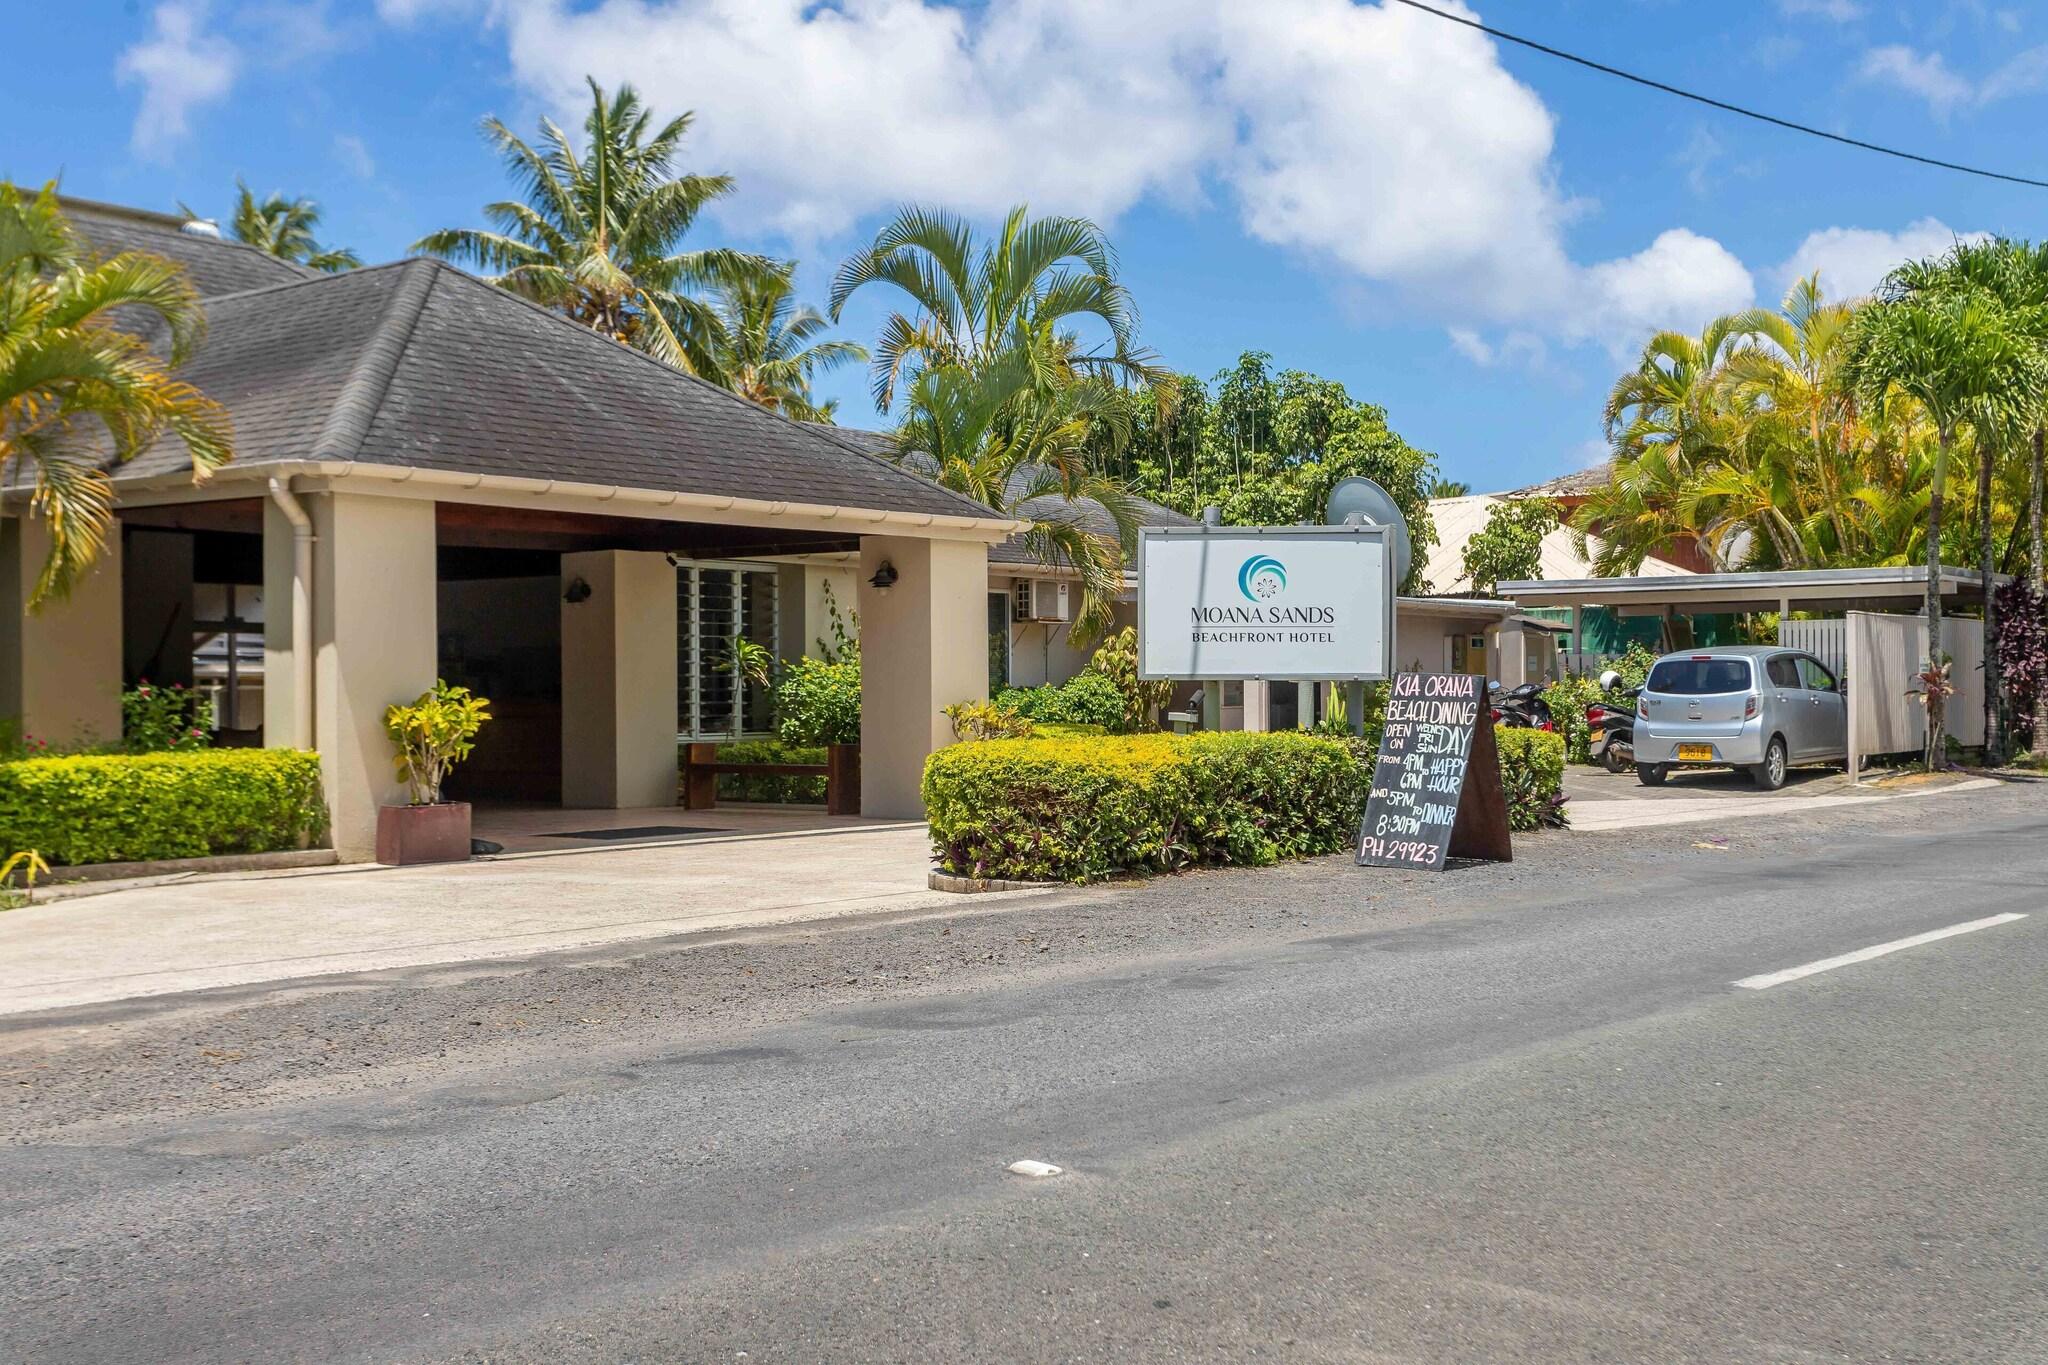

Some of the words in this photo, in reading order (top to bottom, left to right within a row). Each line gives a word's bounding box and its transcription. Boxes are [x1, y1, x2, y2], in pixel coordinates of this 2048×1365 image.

[1191, 606, 1264, 624] MOANA
[1269, 606, 1334, 624] SANDS
[1192, 633, 1284, 643] BEACHFRONT
[1290, 633, 1335, 643] HOTEL
[1394, 674, 1420, 696] KIA
[1425, 676, 1473, 697] ORANA
[1387, 700, 1429, 722] BEACH
[1430, 702, 1477, 725] DINING
[1386, 723, 1412, 737] OPEN
[1418, 734, 1434, 744] FRI
[1390, 738, 1403, 749] ON
[1416, 743, 1437, 753] SUN
[1378, 755, 1400, 764] FROM
[1403, 753, 1424, 771] 4PM
[1430, 758, 1468, 776] HAPPY
[1400, 774, 1422, 790] 6PM
[1427, 775, 1460, 794] HOUR
[1371, 788, 1387, 799] AND
[1387, 791, 1415, 808] 5PM
[1412, 806, 1422, 816] TO
[1420, 803, 1457, 826] DINNER
[1376, 814, 1421, 836] 8:30PM
[1361, 837, 1384, 857] PH
[1386, 840, 1439, 863] 29923
